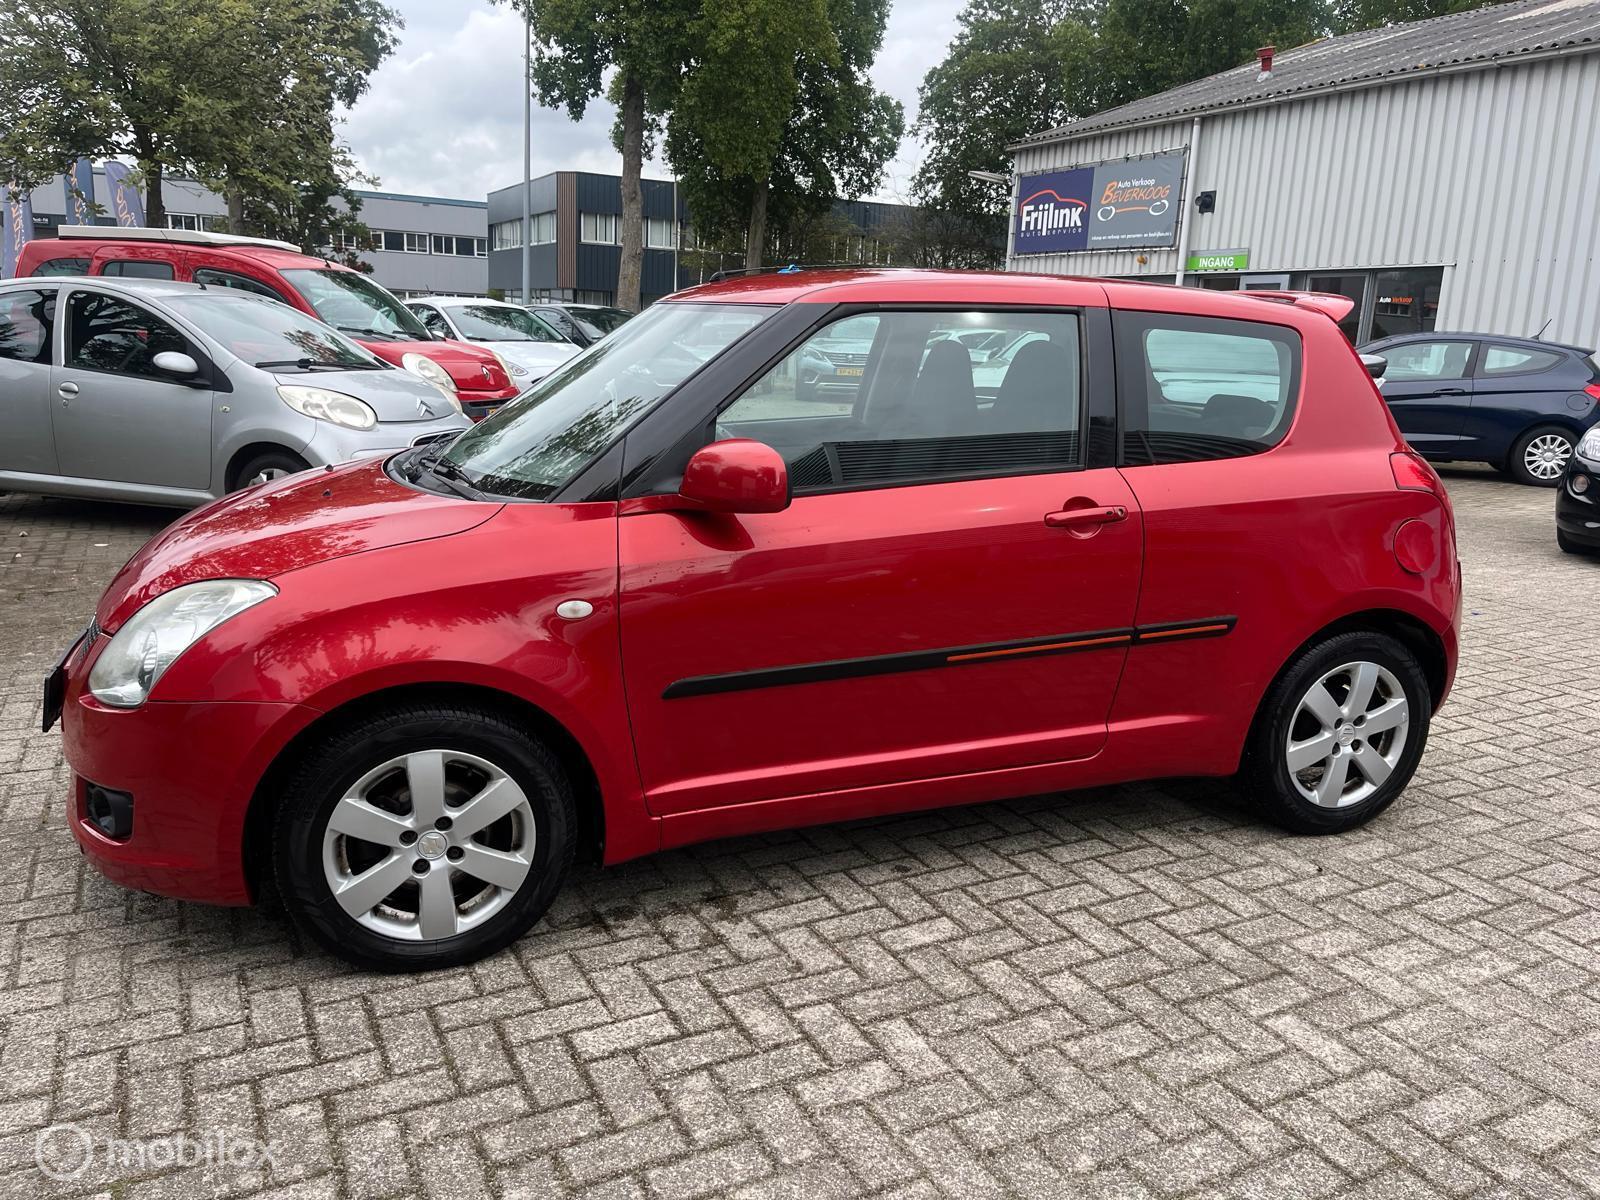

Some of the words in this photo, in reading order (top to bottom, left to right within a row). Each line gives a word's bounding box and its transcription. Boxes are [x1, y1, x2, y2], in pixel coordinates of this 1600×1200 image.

[1118, 181, 1130, 189] Auto
[1132, 178, 1156, 187] Verkoop
[1101, 181, 1171, 205] BEVERKOOG
[1021, 202, 1083, 236] Frijlink
[1199, 256, 1234, 268] INGANG
